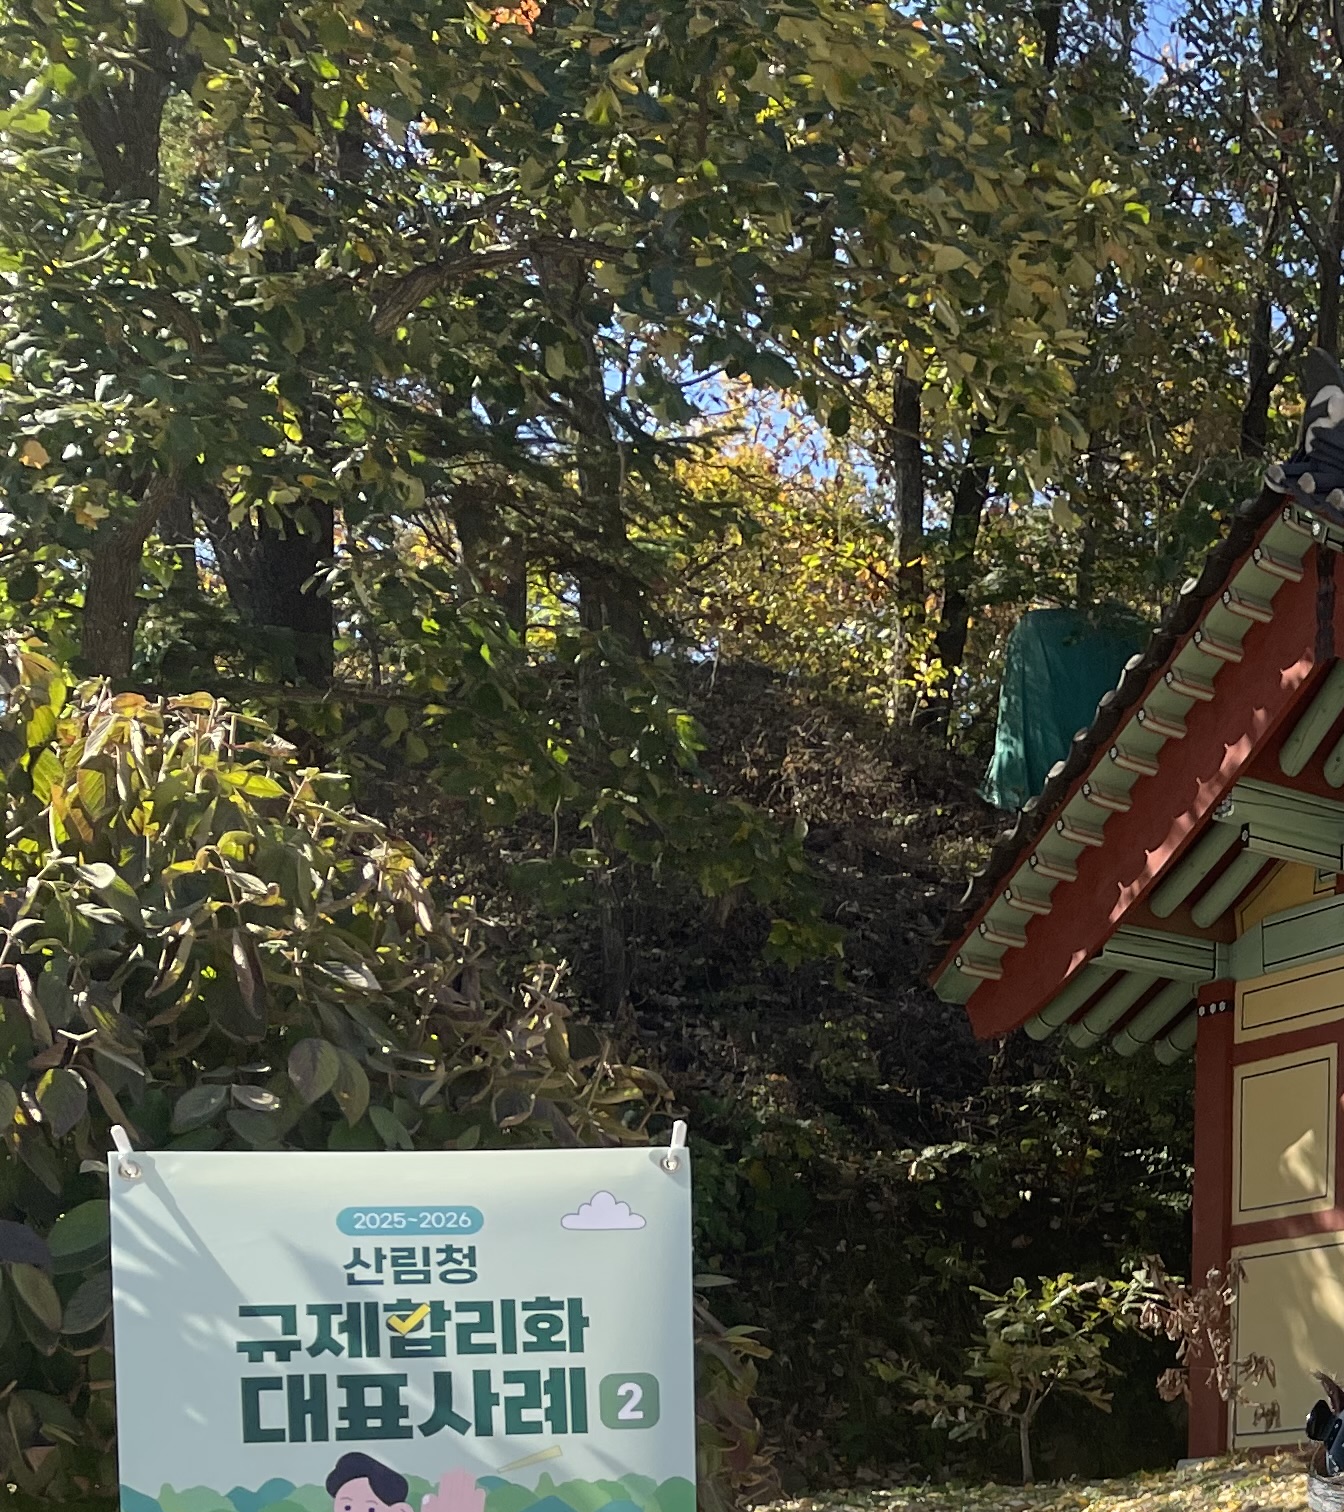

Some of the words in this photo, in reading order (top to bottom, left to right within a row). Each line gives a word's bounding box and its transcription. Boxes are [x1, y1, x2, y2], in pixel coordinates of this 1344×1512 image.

[343, 1244, 478, 1286] 산림청
[236, 1296, 590, 1363] 규제합리화
[240, 1367, 588, 1444] 대표사례
[617, 1382, 643, 1420] 2
